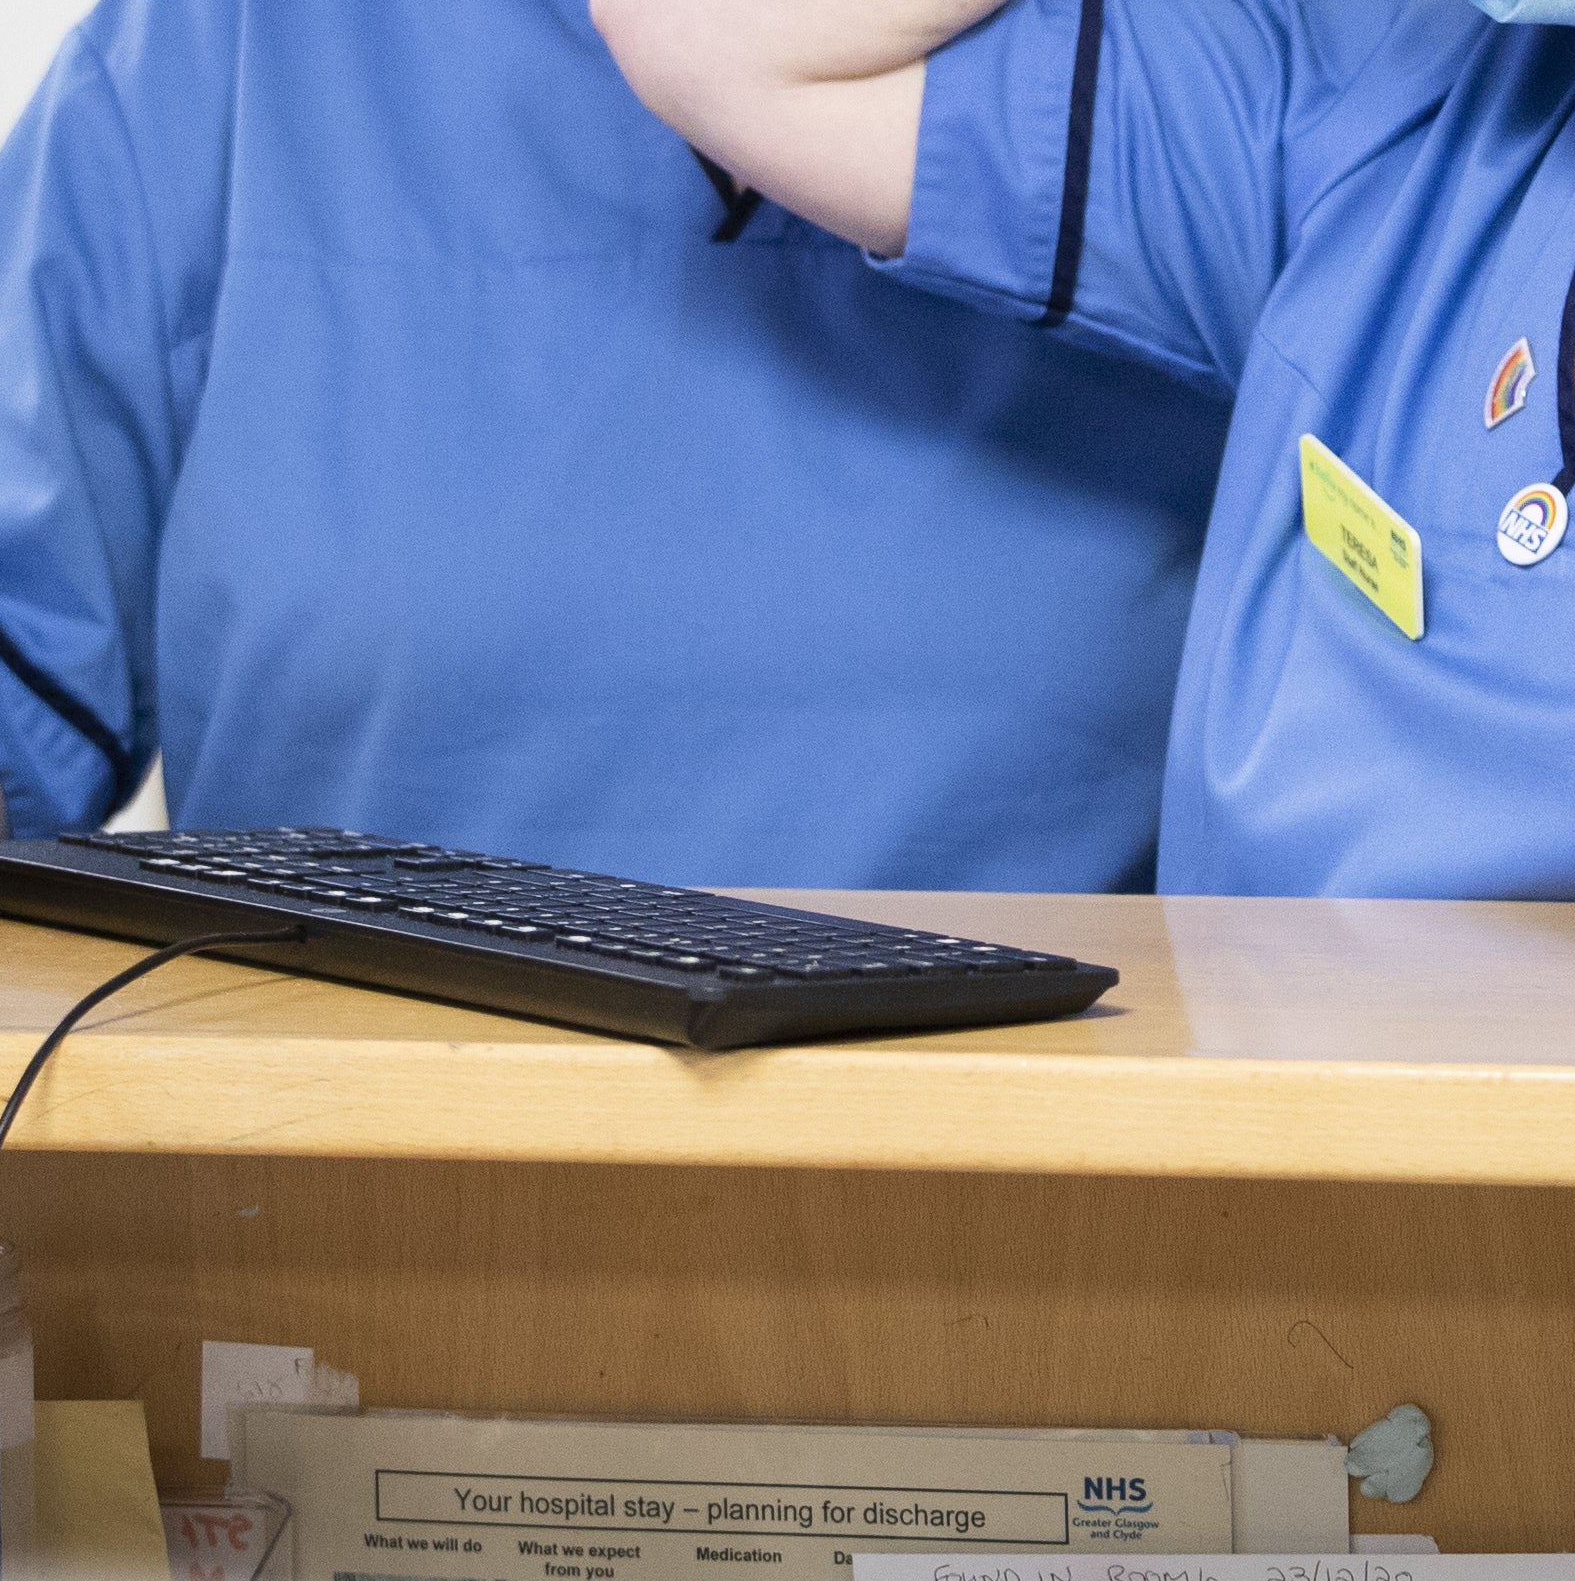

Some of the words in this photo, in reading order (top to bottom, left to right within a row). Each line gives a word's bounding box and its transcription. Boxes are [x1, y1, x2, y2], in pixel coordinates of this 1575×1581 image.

[1499, 509, 1548, 553] NHS
[1084, 1476, 1146, 1501] NHS
[455, 1487, 512, 1512] Your
[521, 1491, 615, 1520] hospital
[624, 1496, 675, 1524] stay
[708, 1497, 813, 1528] planning
[822, 1500, 855, 1524] for
[863, 1502, 986, 1533] discharge
[1072, 1517, 1112, 1528] Greater
[1115, 1518, 1159, 1531] Glasgow
[364, 1533, 403, 1549] What
[408, 1538, 428, 1550] we
[433, 1537, 458, 1552] will
[463, 1539, 482, 1553] do
[1090, 1529, 1110, 1539] and
[1113, 1530, 1142, 1540] Clyde
[518, 1541, 558, 1555] What
[562, 1545, 584, 1557] we
[589, 1545, 641, 1561] expect
[696, 1546, 782, 1563] Medication
[545, 1562, 580, 1576] from
[586, 1564, 615, 1580] you
